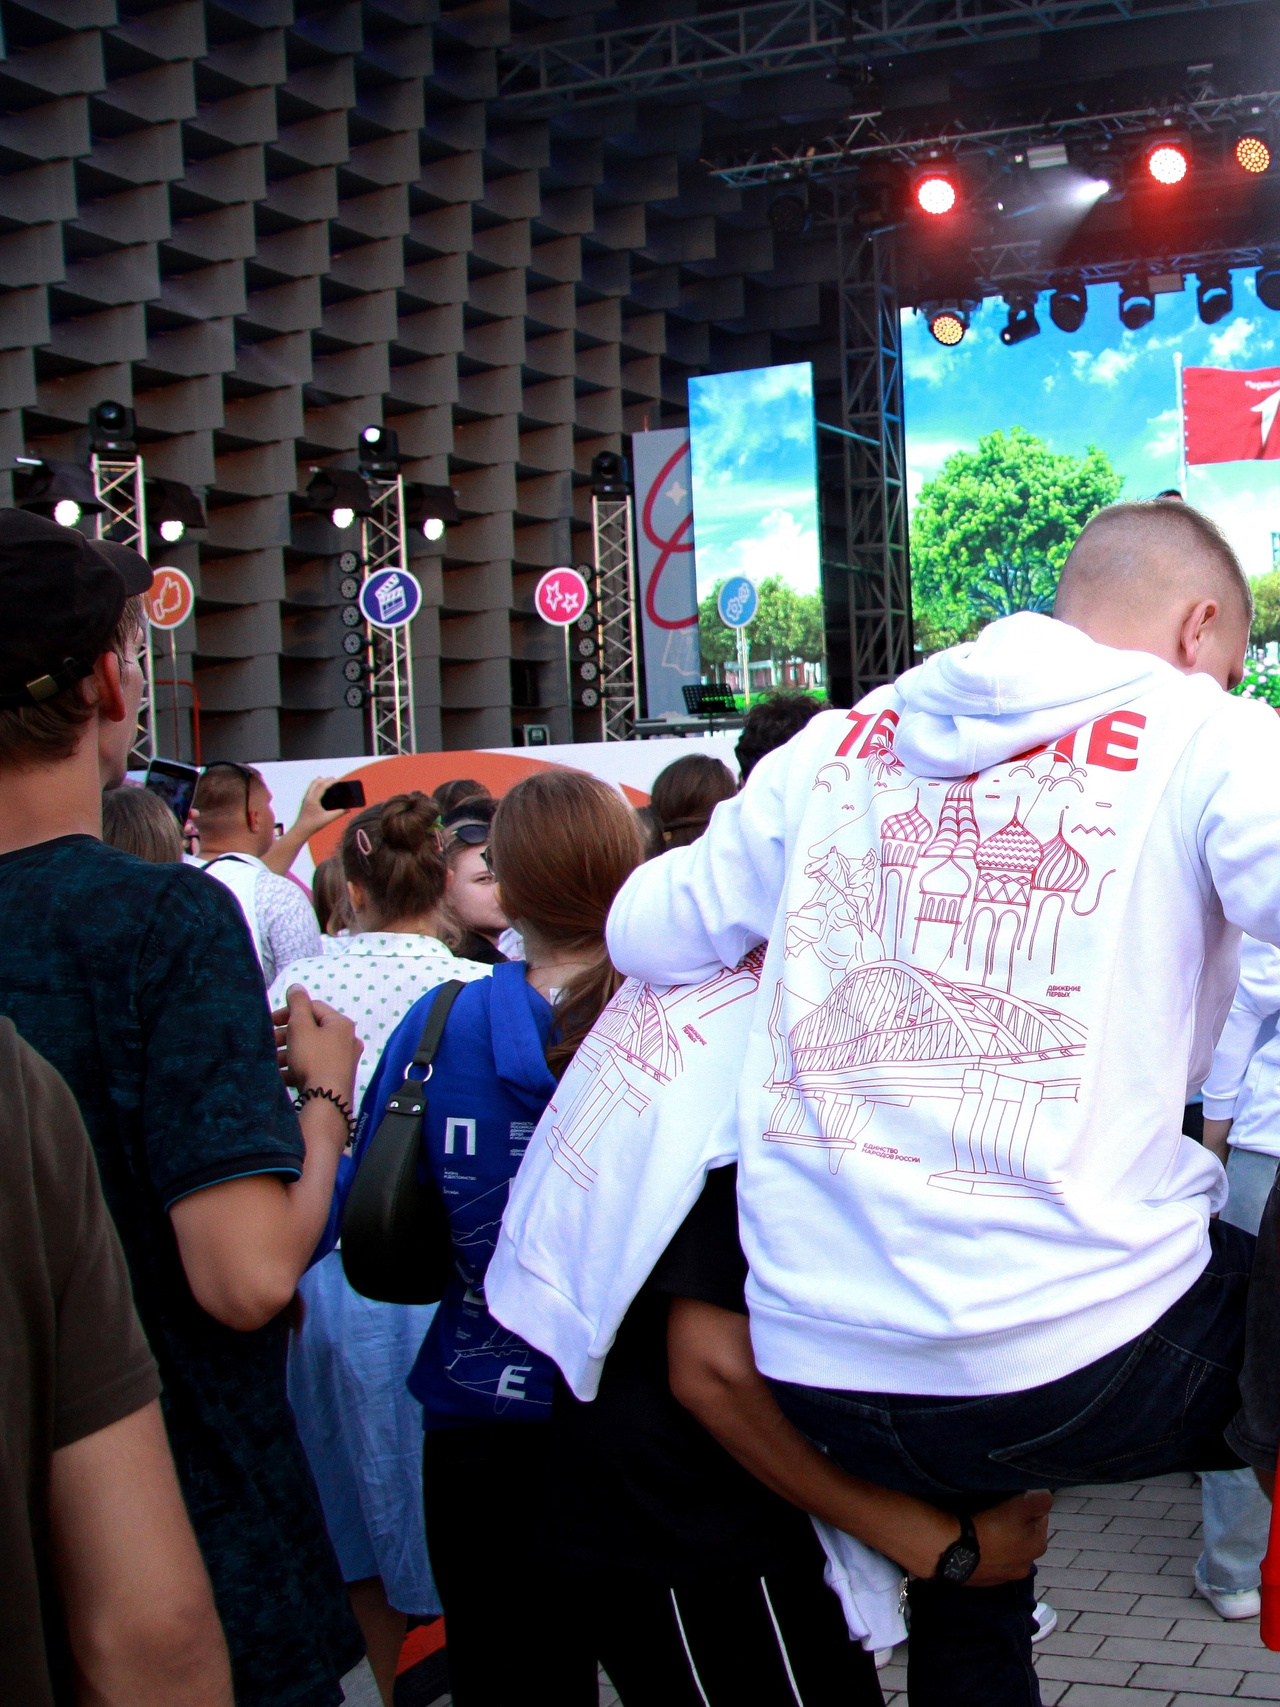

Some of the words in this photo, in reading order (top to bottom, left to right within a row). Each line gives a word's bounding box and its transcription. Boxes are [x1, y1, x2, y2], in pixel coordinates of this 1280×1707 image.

[445, 1117, 476, 1155] П
[863, 1142, 899, 1154] ЕДИНСТВО
[861, 1148, 895, 1160] НАРОДОВ
[895, 1154, 921, 1163] РОССИИ
[496, 1365, 533, 1400] Е
